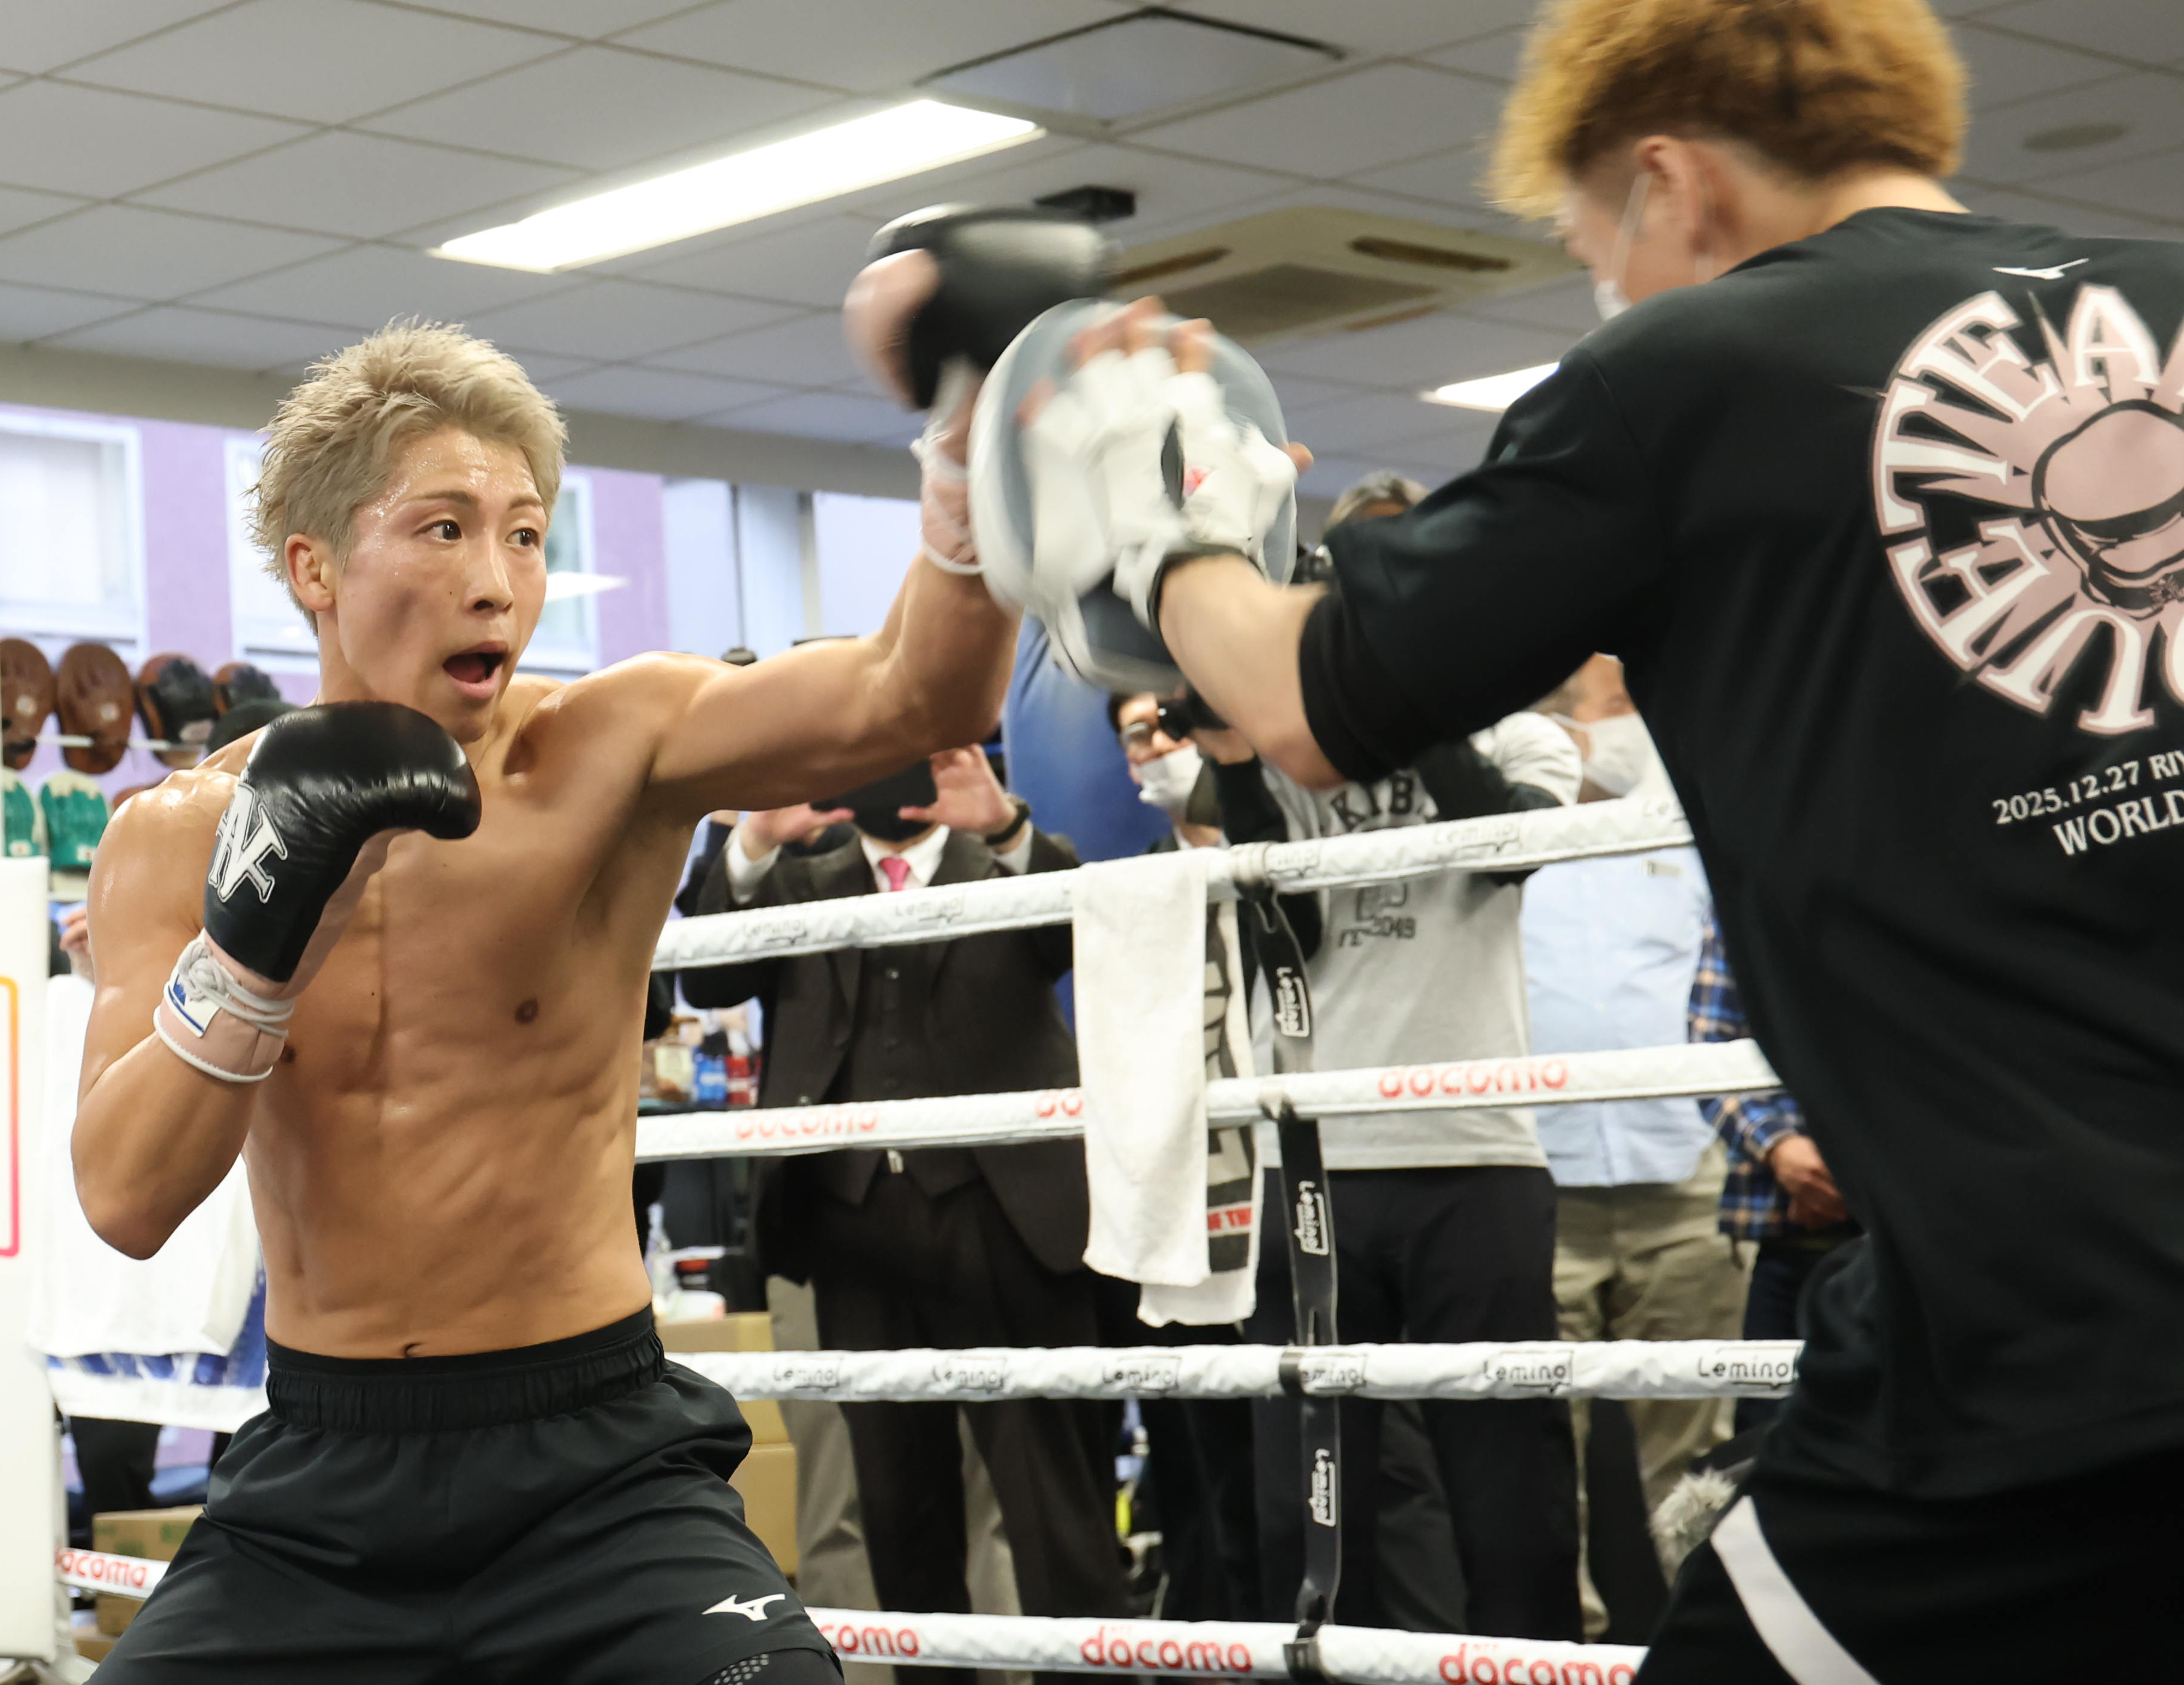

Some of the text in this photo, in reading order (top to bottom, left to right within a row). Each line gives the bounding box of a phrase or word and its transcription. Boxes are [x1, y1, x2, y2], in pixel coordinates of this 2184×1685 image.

[1992, 761, 2140, 825] 2025.12.27
[2052, 789, 2184, 856] WORLD
[1378, 1058, 1569, 1099] docomo
[1103, 1364, 1174, 1383] Lemino
[1300, 1361, 1361, 1382] emino
[1483, 1359, 1567, 1380] Lemino
[1697, 1356, 1790, 1378] Lemino
[1080, 1626, 1252, 1672] docomo
[1439, 1643, 1637, 1685] docomo
